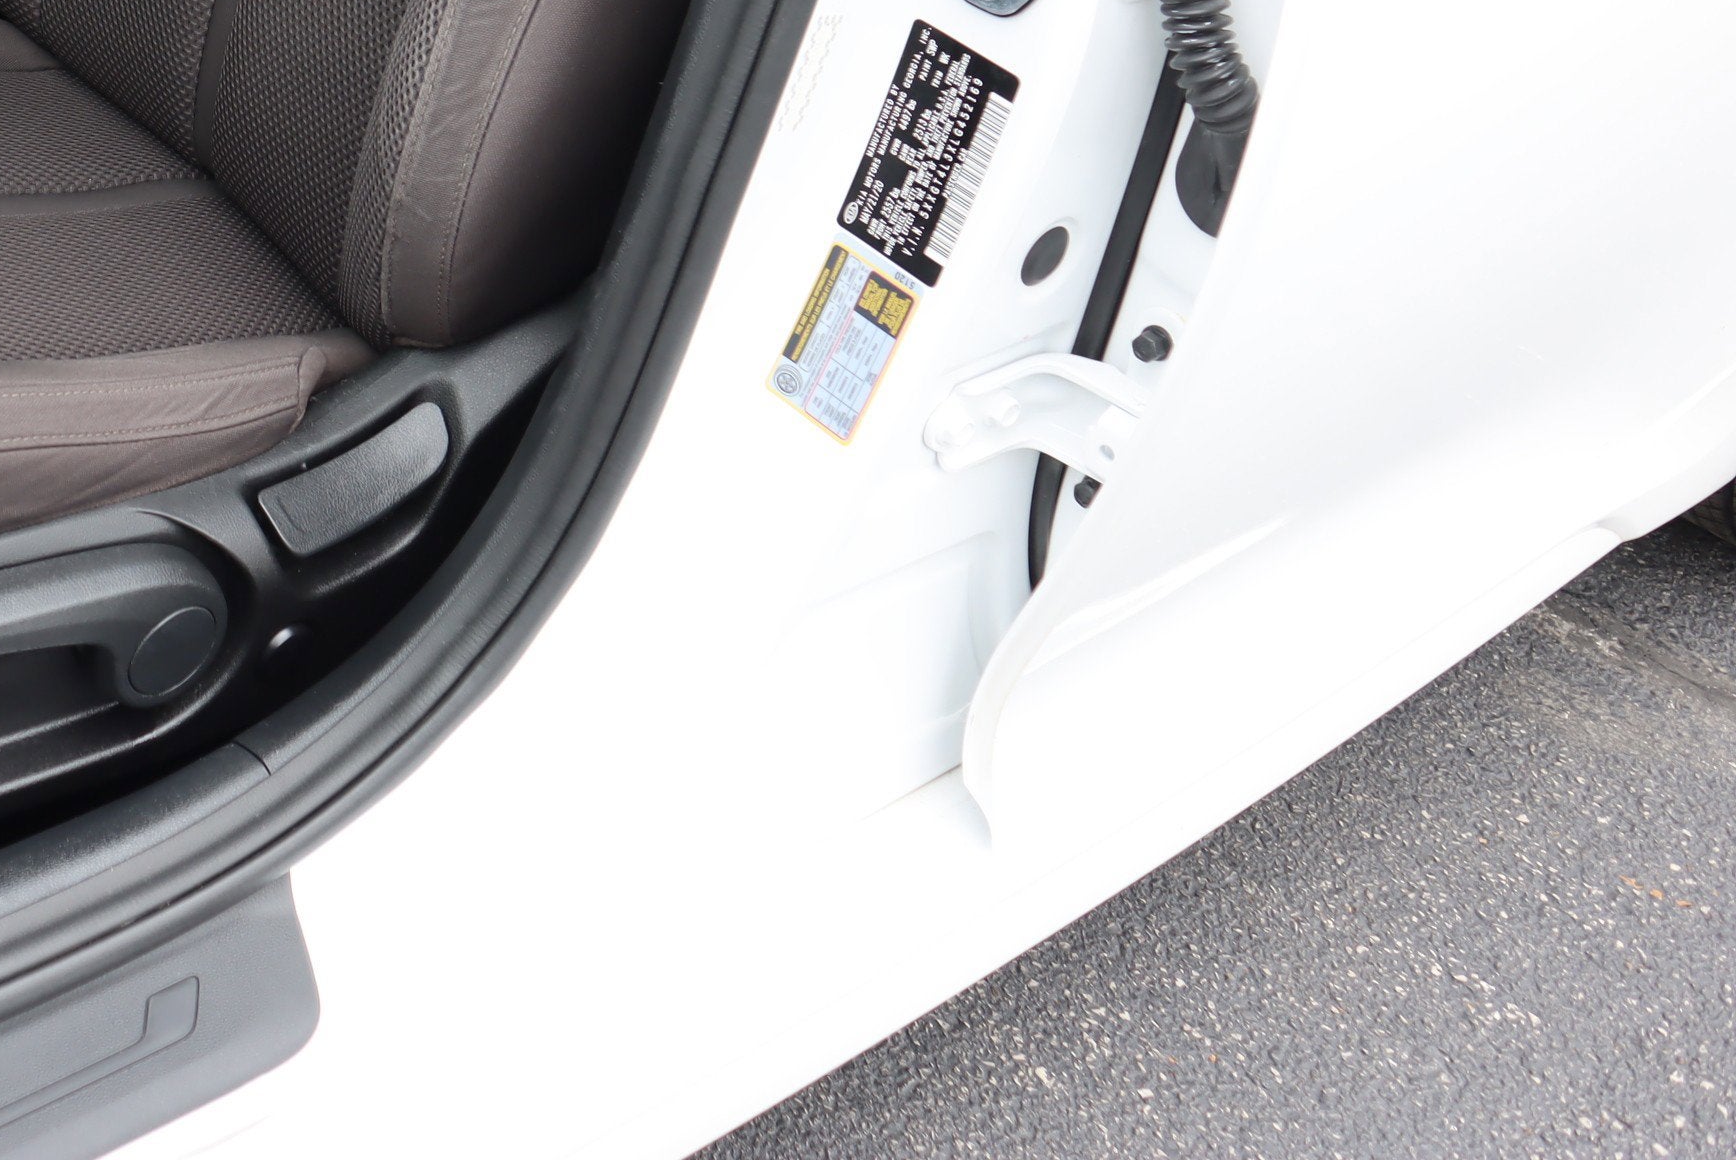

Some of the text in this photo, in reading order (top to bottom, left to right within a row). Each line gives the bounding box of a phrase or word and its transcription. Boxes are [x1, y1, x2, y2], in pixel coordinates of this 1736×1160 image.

[919, 39, 938, 81] PAINT SWP
[855, 27, 932, 206] KIA MOTORS MANUFACTURING GEORGIA, INC.
[866, 83, 900, 158] MANUFACTURED BY
[859, 180, 884, 224] MAY/21/20
[901, 226, 925, 257] V.I.N.
